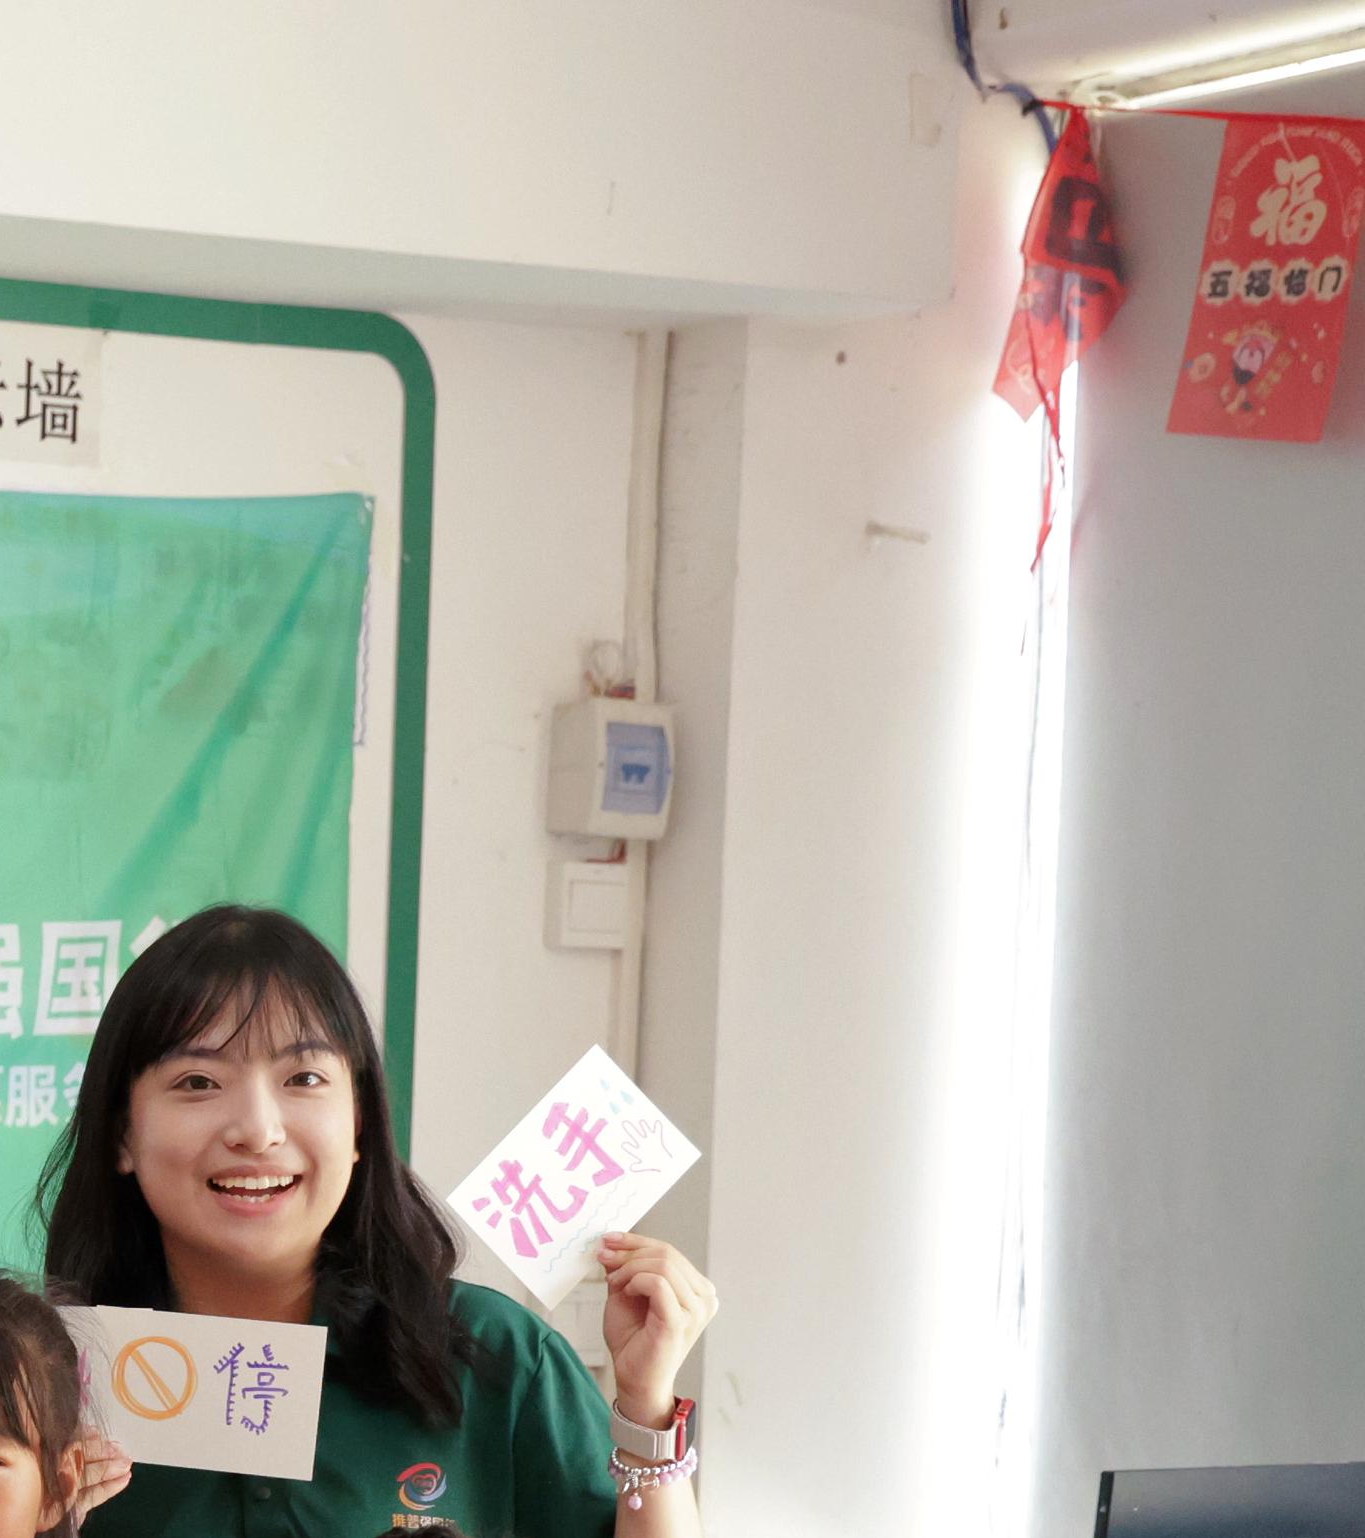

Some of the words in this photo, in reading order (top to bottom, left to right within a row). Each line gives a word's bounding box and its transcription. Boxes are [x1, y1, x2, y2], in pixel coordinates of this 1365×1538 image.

[1250, 154, 1327, 246] 福
[473, 1101, 624, 1258] 洗手
[214, 1342, 289, 1436] 停
